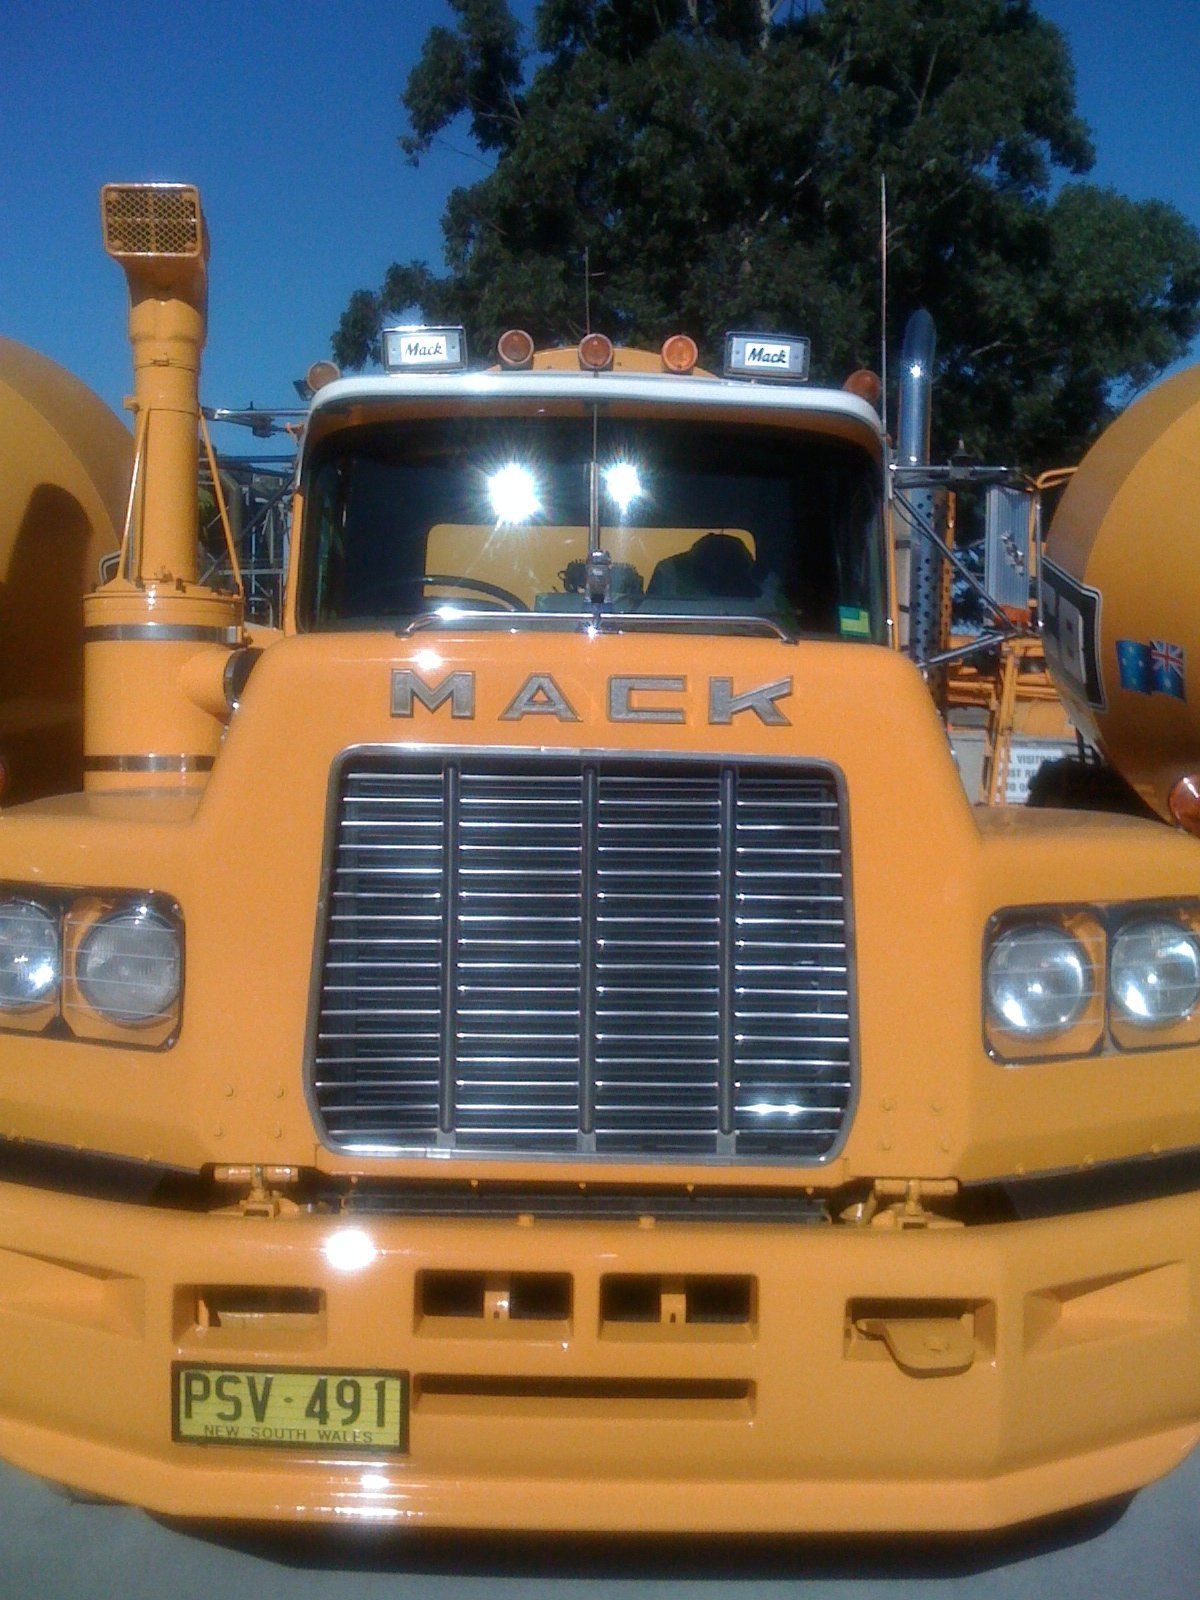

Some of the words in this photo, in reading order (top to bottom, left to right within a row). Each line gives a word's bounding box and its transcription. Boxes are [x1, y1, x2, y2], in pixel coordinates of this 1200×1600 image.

[405, 342, 443, 356] Mack
[748, 347, 787, 364] Mack
[389, 667, 795, 727] MACK
[204, 1425, 240, 1438] NEW
[251, 1427, 307, 1442] SOUTH
[317, 1429, 374, 1445] WALES
